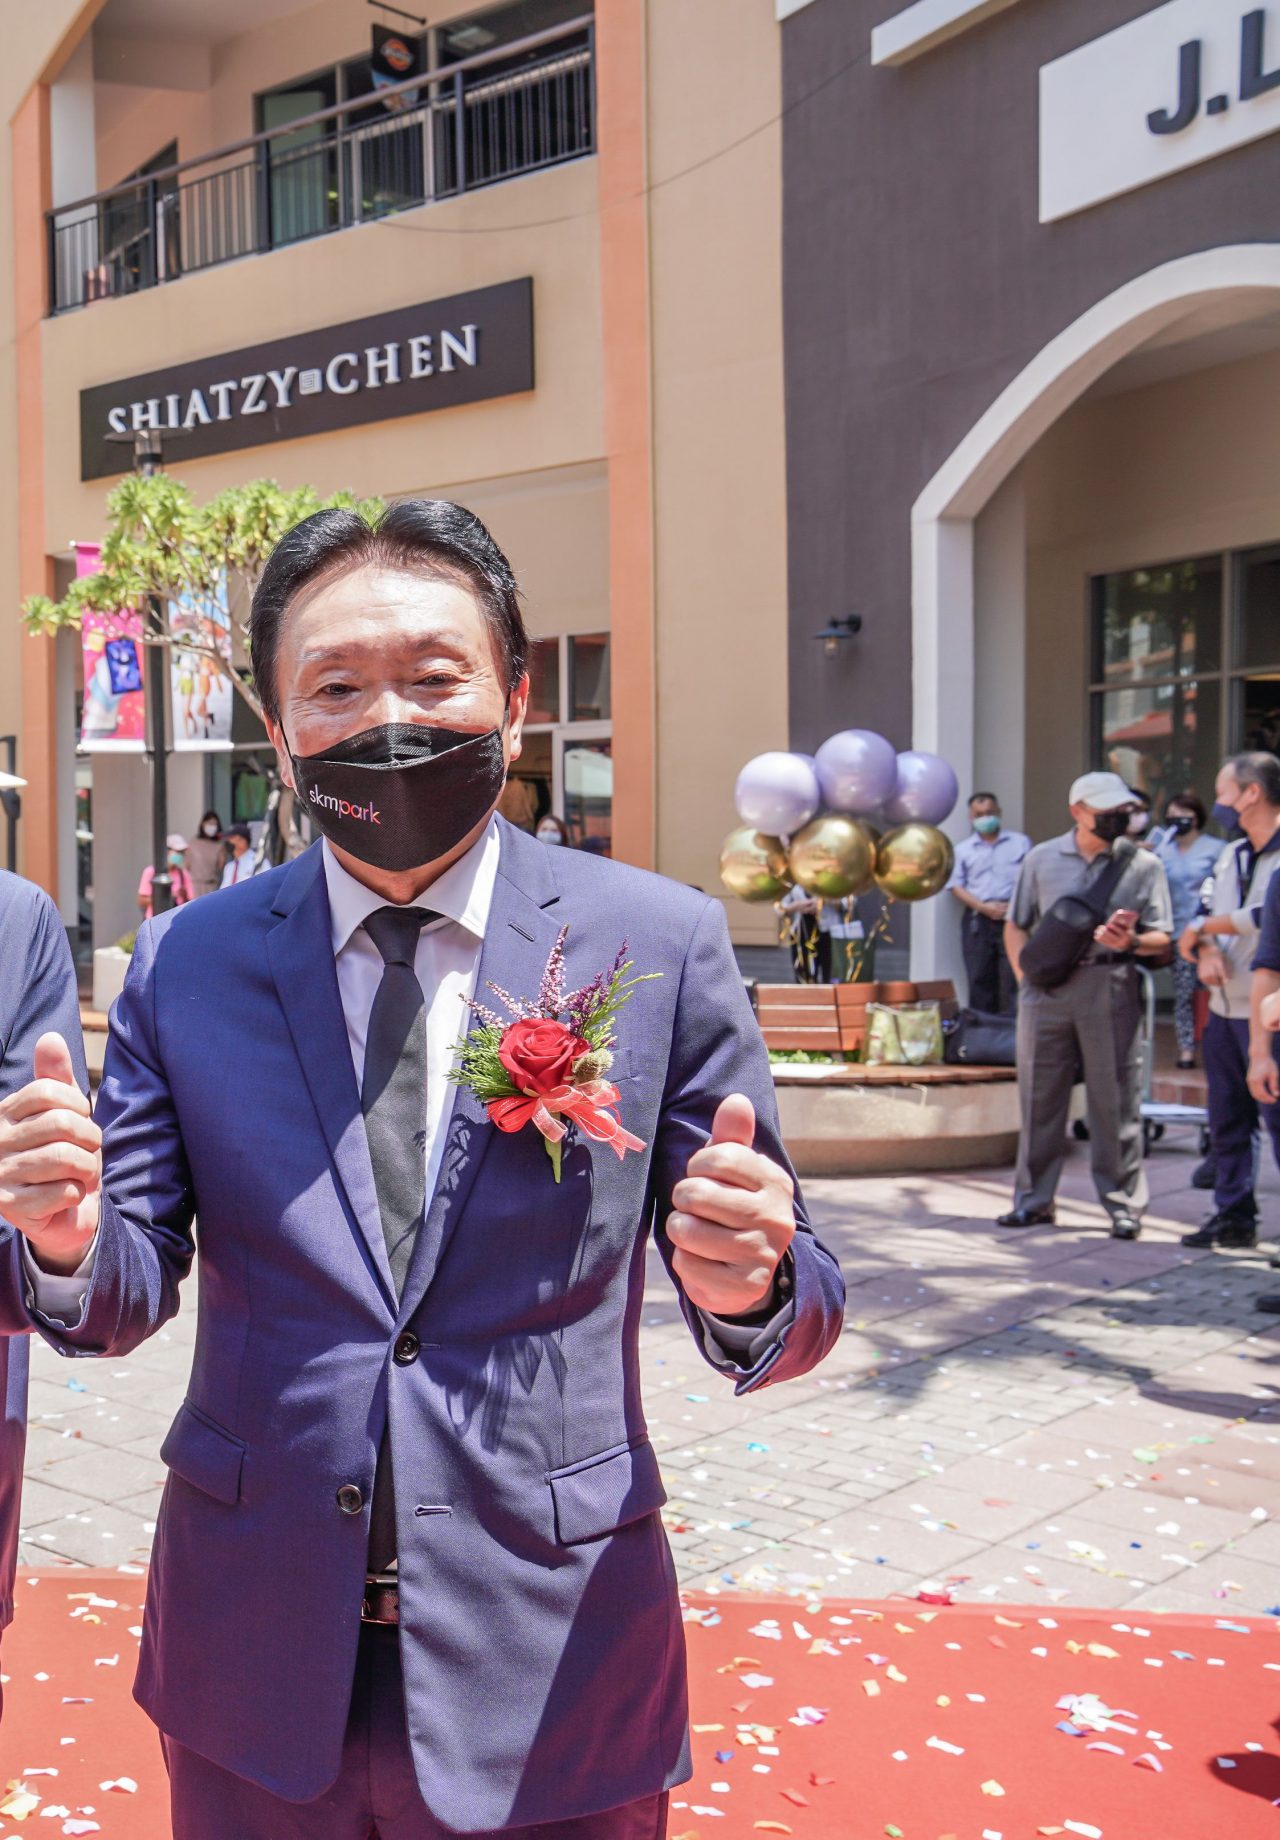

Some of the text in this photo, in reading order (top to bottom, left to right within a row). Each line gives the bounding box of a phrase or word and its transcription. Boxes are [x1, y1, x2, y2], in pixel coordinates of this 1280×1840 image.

[107, 323, 479, 433] SHIATZY CHEN
[309, 783, 381, 825] skmpark
